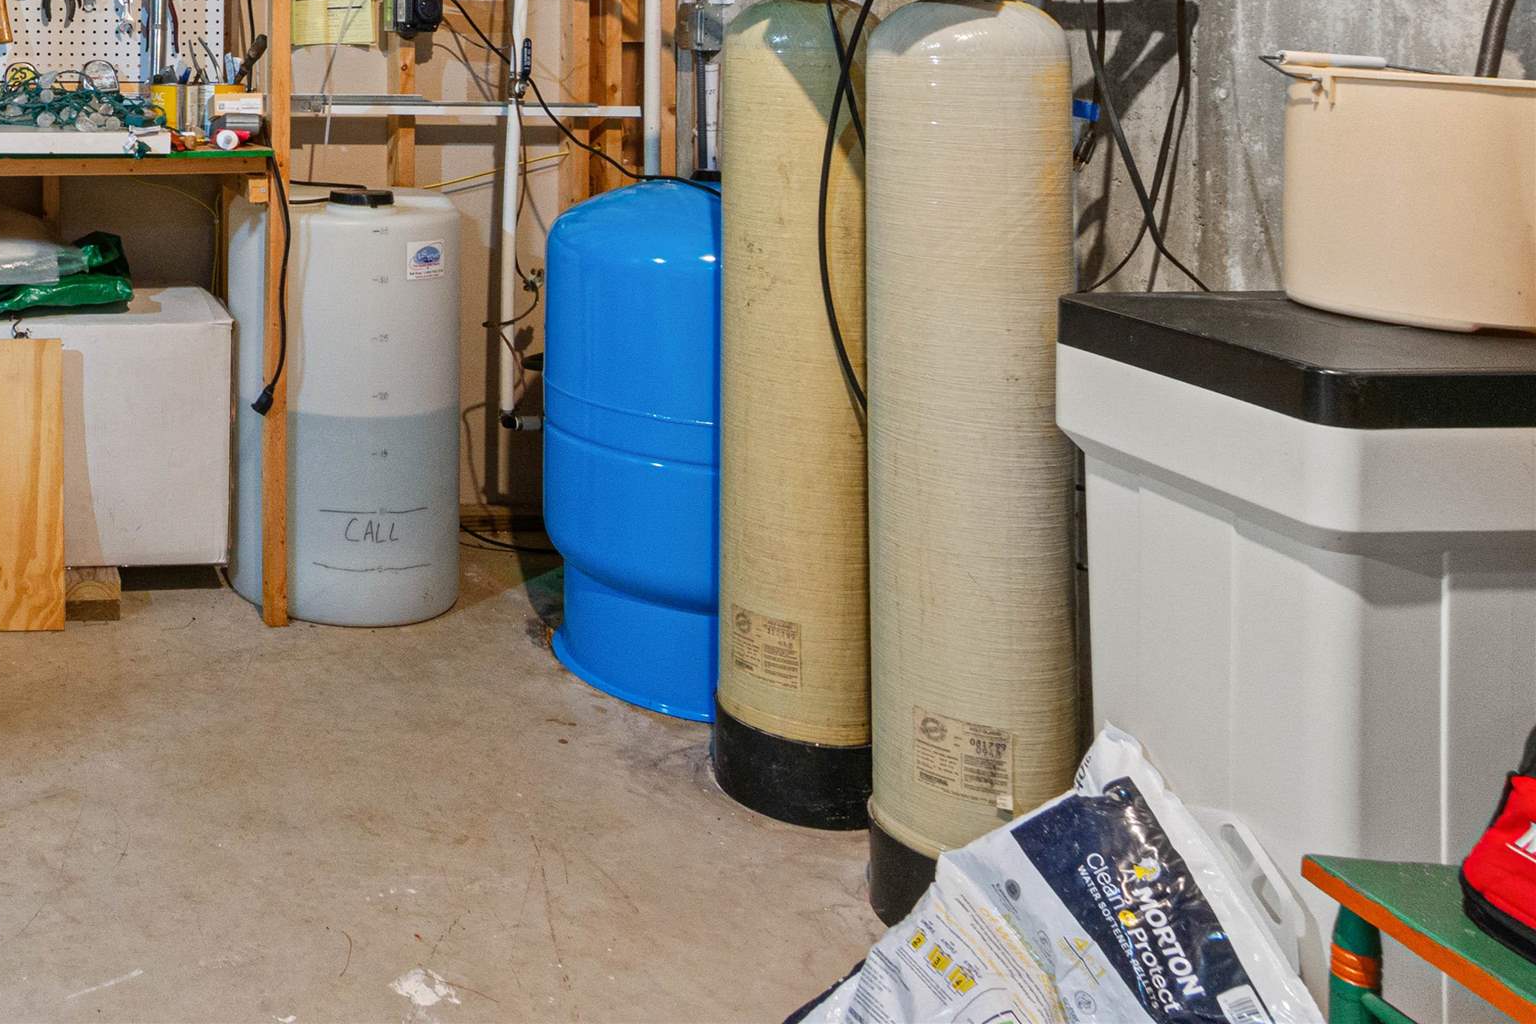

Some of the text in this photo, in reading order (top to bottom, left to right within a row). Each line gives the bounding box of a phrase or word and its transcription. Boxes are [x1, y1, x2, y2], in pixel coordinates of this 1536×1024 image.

[344, 517, 399, 544] CALL
[1077, 865, 1160, 1010] WATER SOFTENER PELLETS
[1086, 852, 1183, 1013] Clean Protect
[1132, 886, 1205, 998] MORTON
